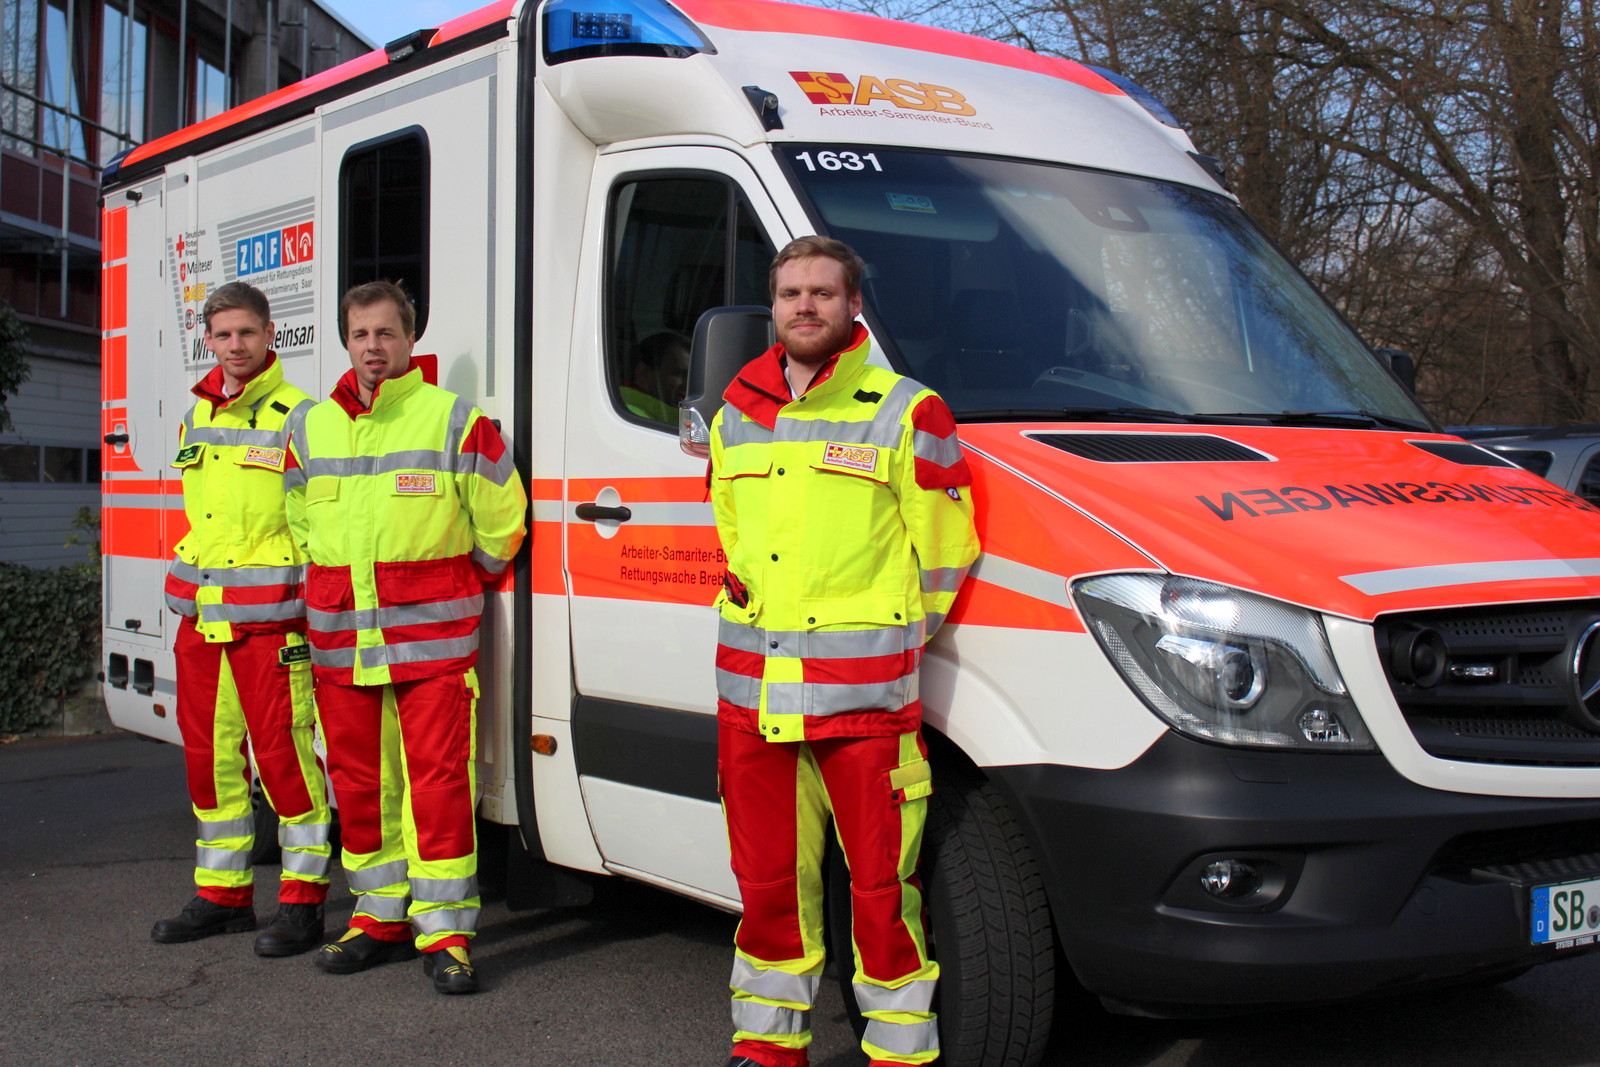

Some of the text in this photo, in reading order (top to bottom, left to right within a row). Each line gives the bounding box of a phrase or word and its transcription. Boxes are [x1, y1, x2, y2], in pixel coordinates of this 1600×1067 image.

[853, 74, 976, 117] ASB
[819, 106, 994, 131] Arbeiter-Samariter-Bund
[795, 150, 883, 172] 1631
[240, 238, 277, 271] ZRF
[186, 258, 213, 275] Malteser
[276, 264, 313, 280] Rettungsdienst
[301, 279, 313, 289] Saar
[840, 448, 875, 463] ASB
[408, 475, 432, 487] ASB
[620, 566, 697, 585] Rettungswache
[1553, 889, 1584, 932] SB
[1537, 920, 1545, 932] D
